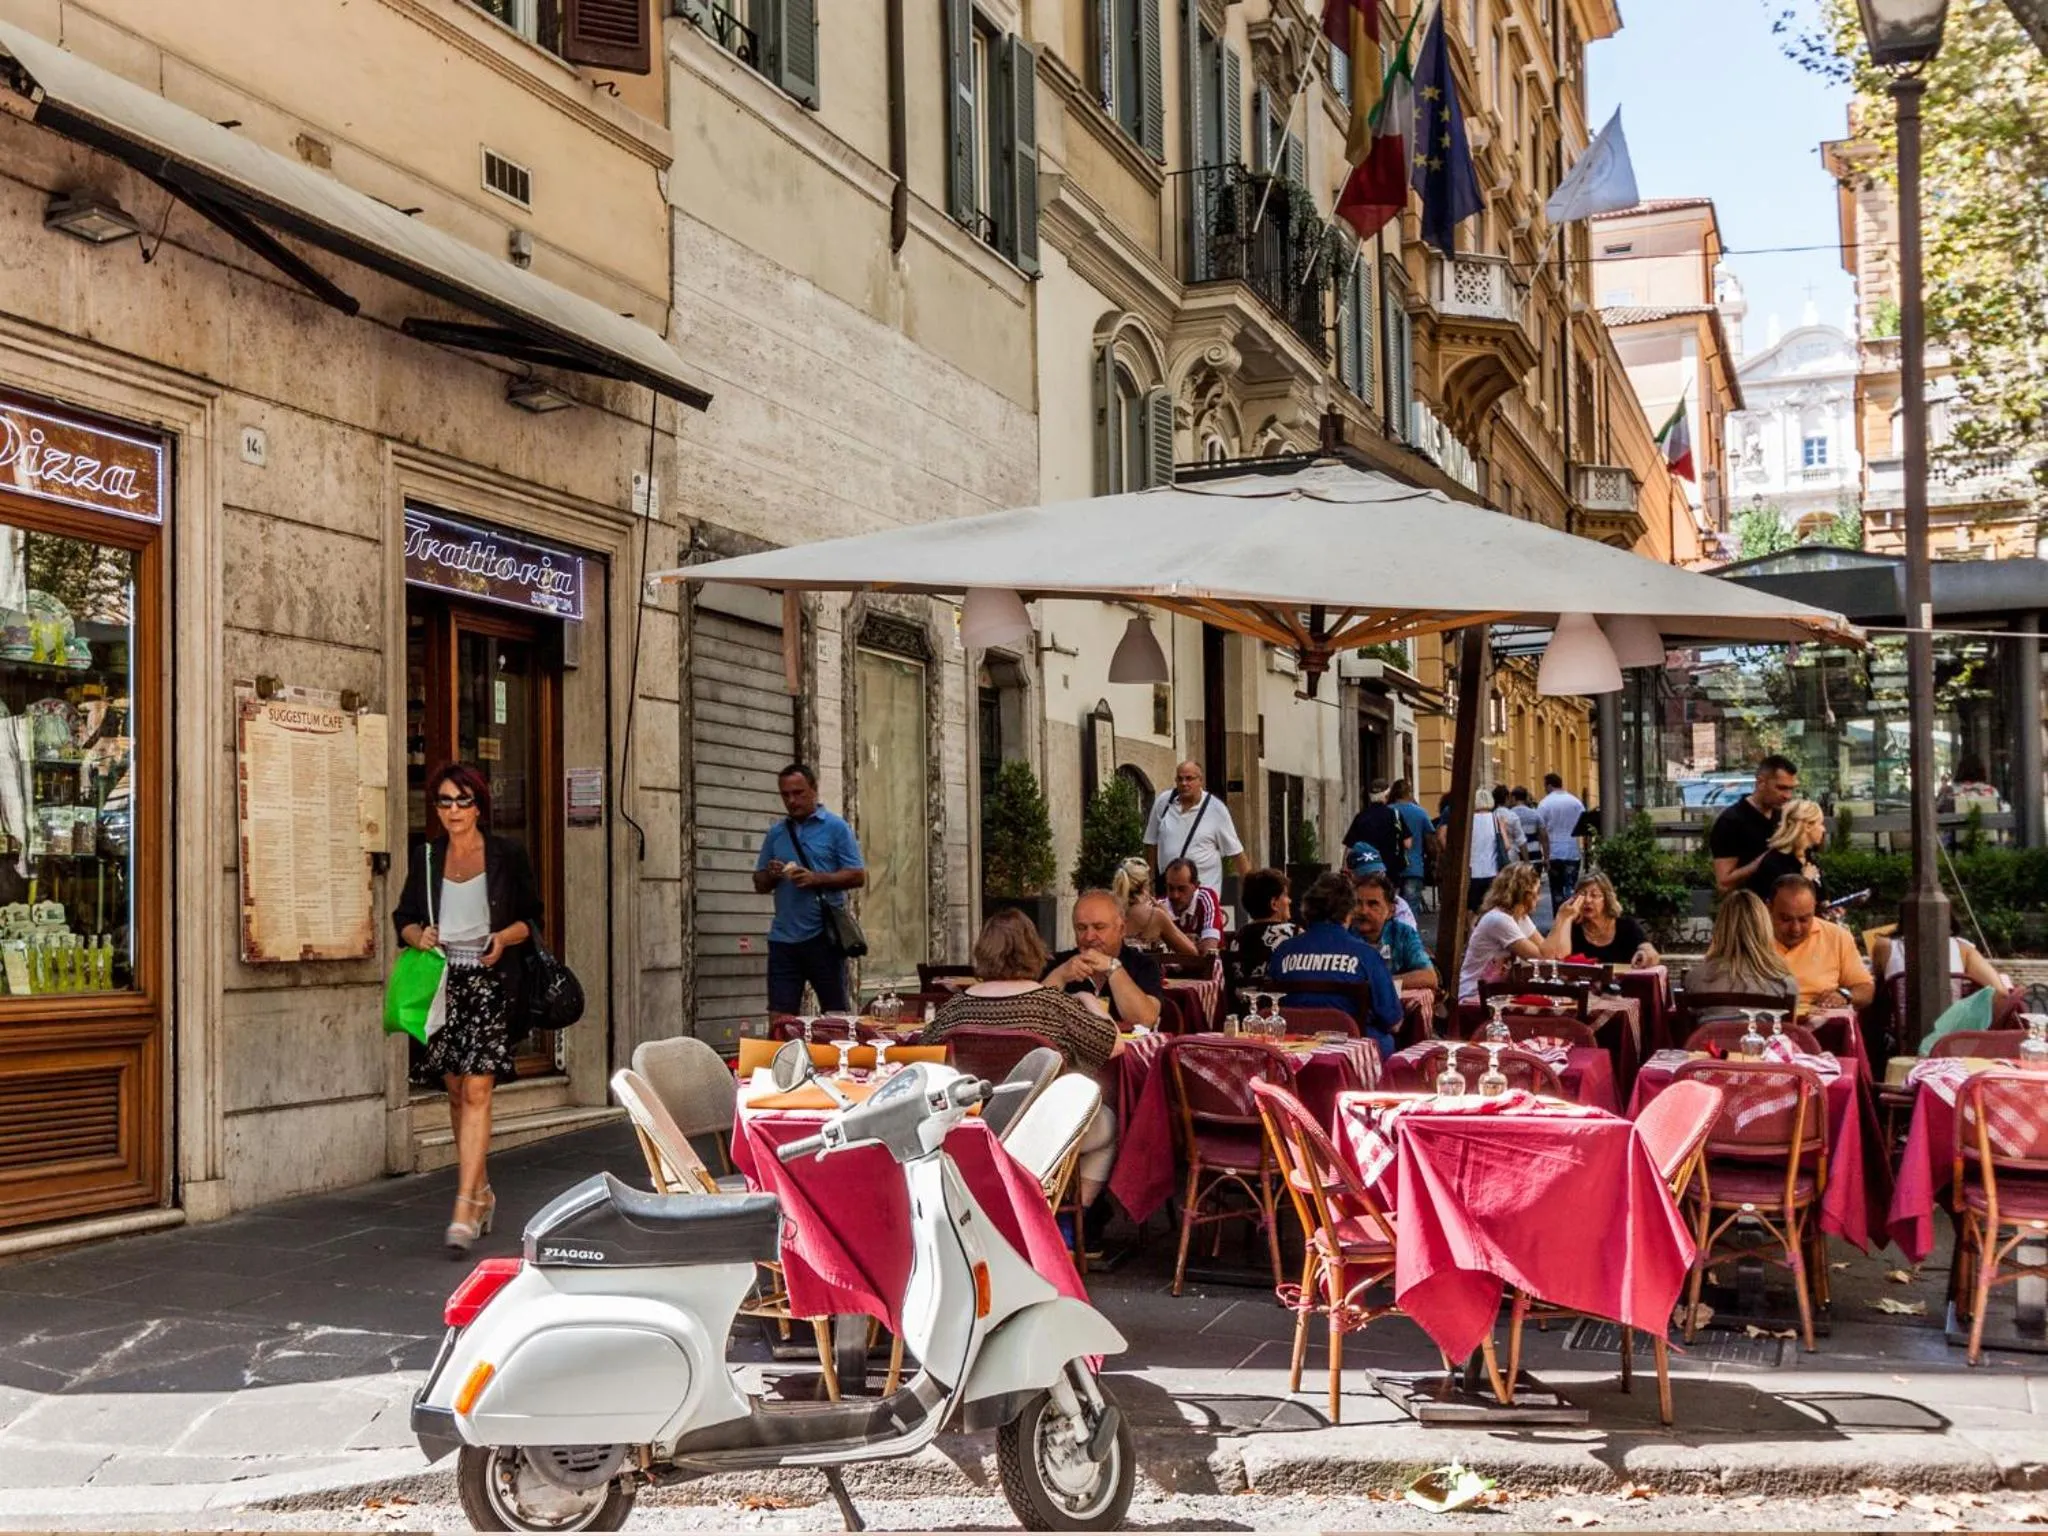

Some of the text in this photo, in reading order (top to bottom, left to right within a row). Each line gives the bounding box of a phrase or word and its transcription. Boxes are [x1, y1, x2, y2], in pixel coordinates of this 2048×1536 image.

[404, 516, 575, 595] Trattoria
[268, 708, 320, 726] SUGGESTUM
[1281, 953, 1359, 974] VOLUNTEER
[543, 1247, 604, 1260] PIAGGIO
